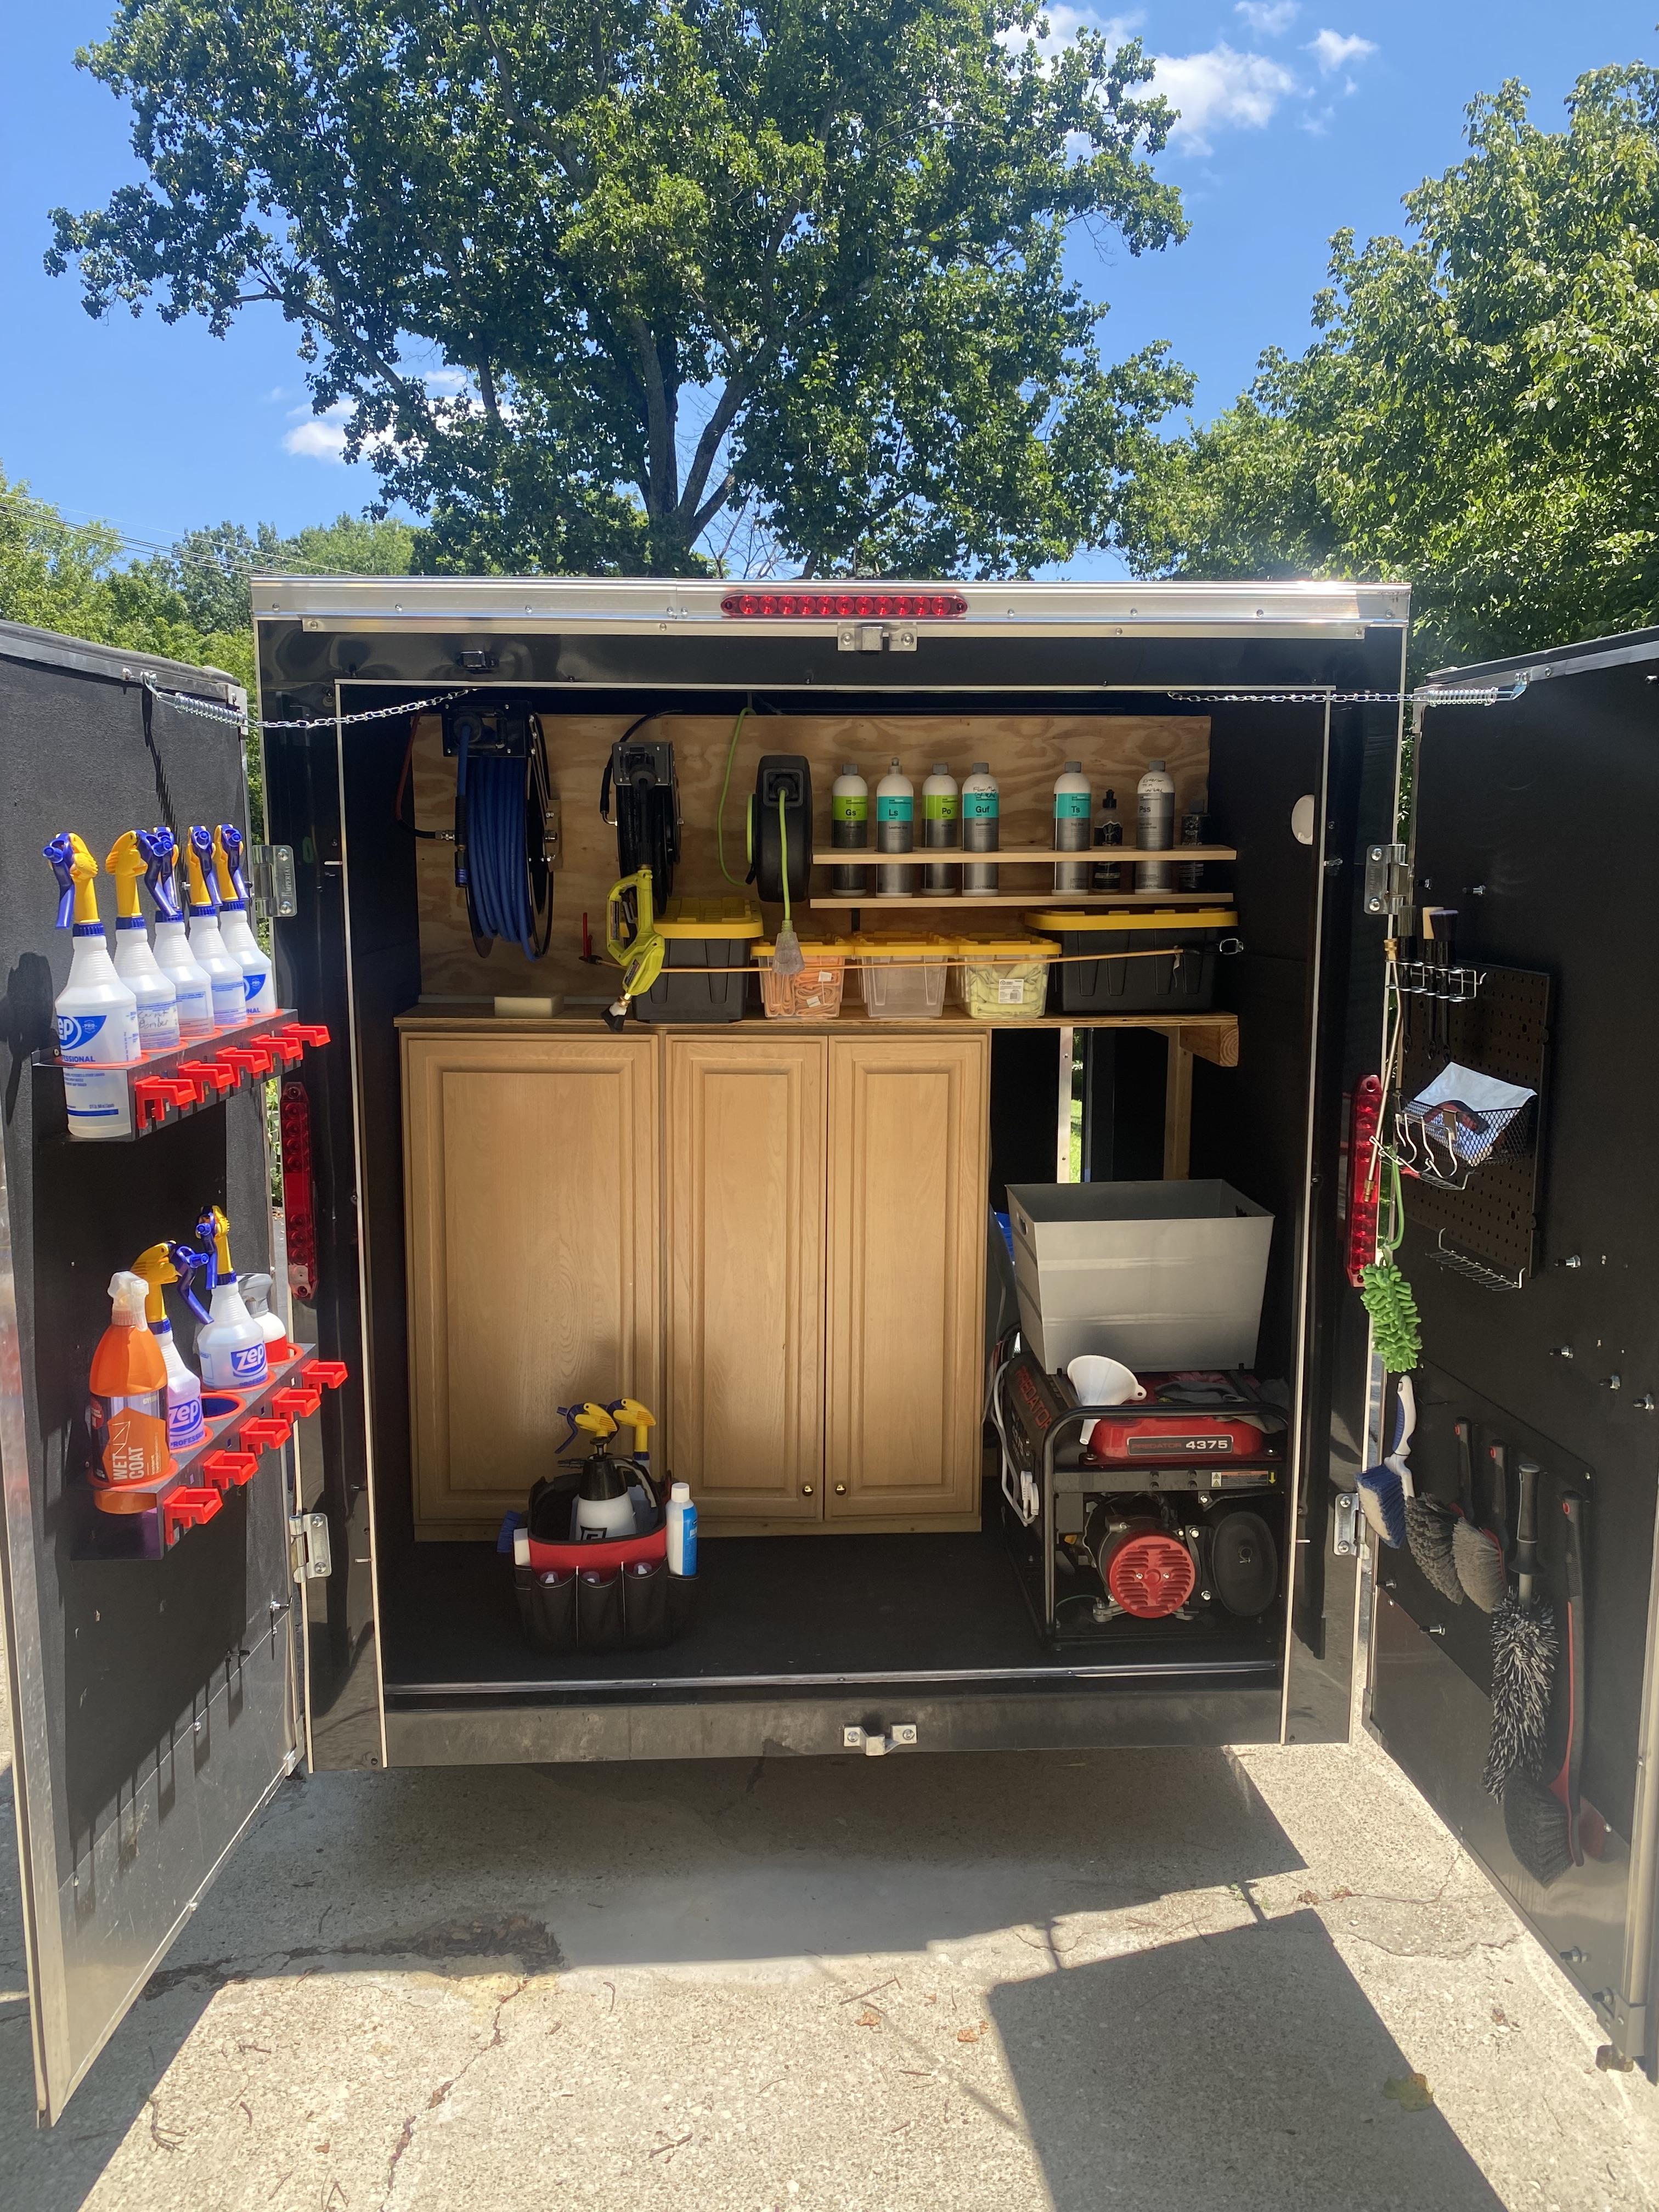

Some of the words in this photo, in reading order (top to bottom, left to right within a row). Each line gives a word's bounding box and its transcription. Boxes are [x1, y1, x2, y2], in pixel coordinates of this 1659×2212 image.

[281, 866, 292, 897] IMPERIAL
[1186, 1440, 1228, 1449] 4375
[112, 1454, 128, 1480] WET
[128, 1447, 144, 1480] COAT
